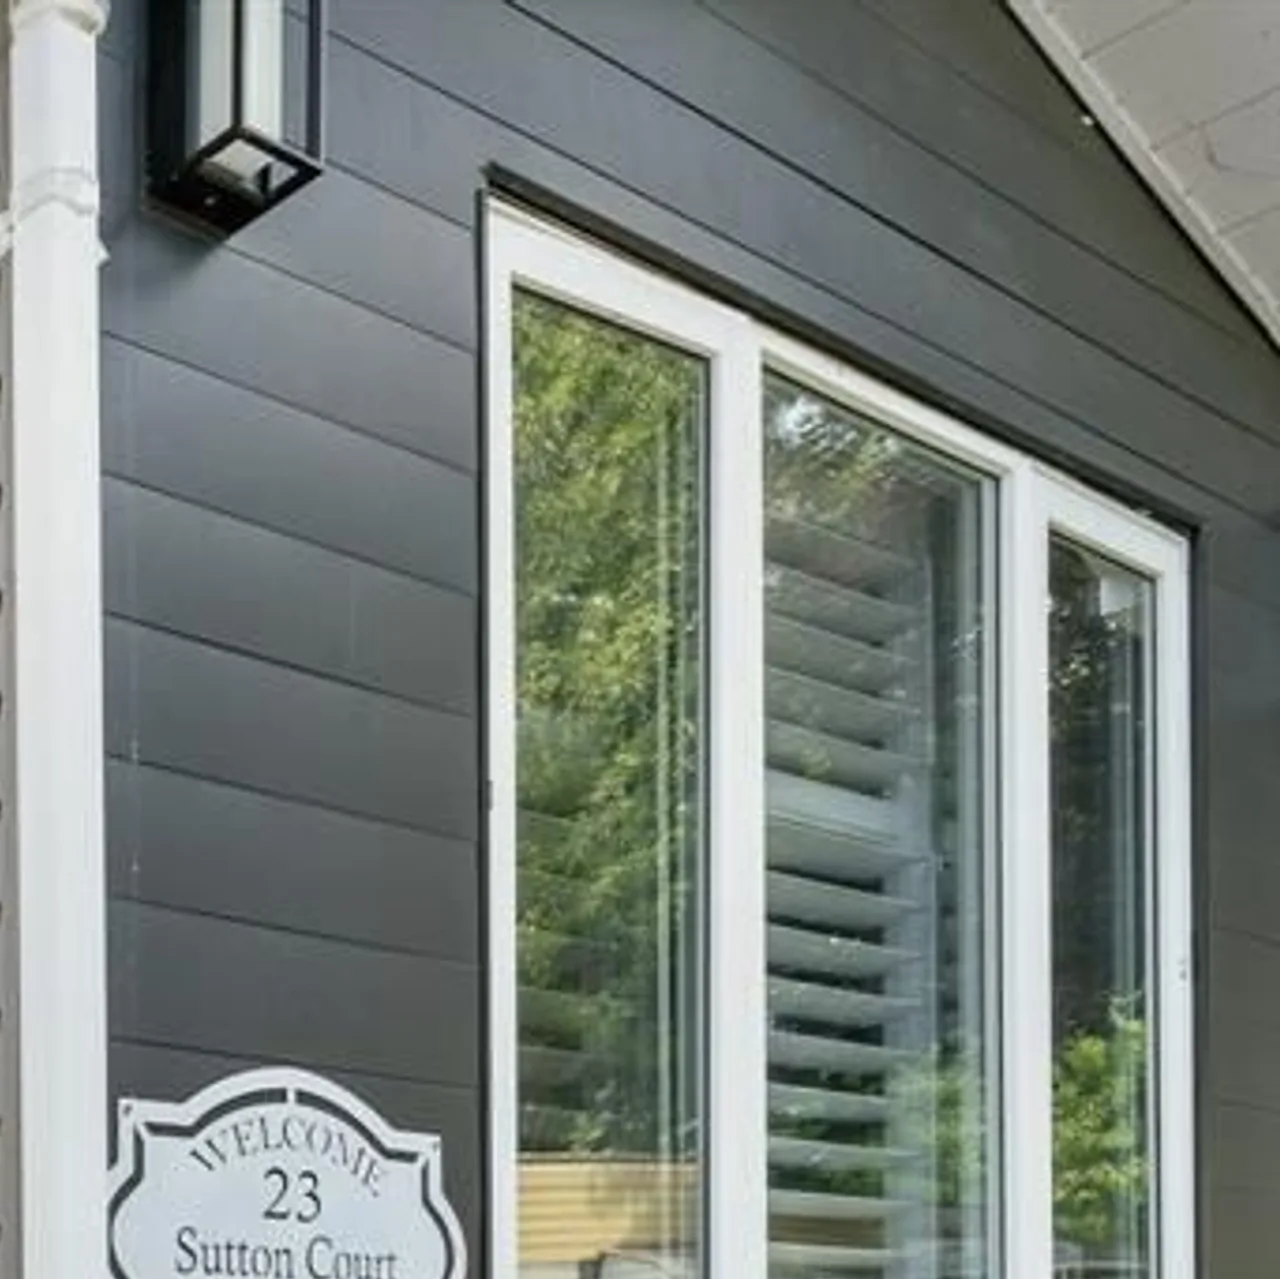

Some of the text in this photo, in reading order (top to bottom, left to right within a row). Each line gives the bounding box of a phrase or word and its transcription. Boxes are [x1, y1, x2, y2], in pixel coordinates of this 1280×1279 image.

[190, 1116, 387, 1197] WELCOME
[262, 1166, 322, 1223] 23
[175, 1226, 296, 1279] Sutton
